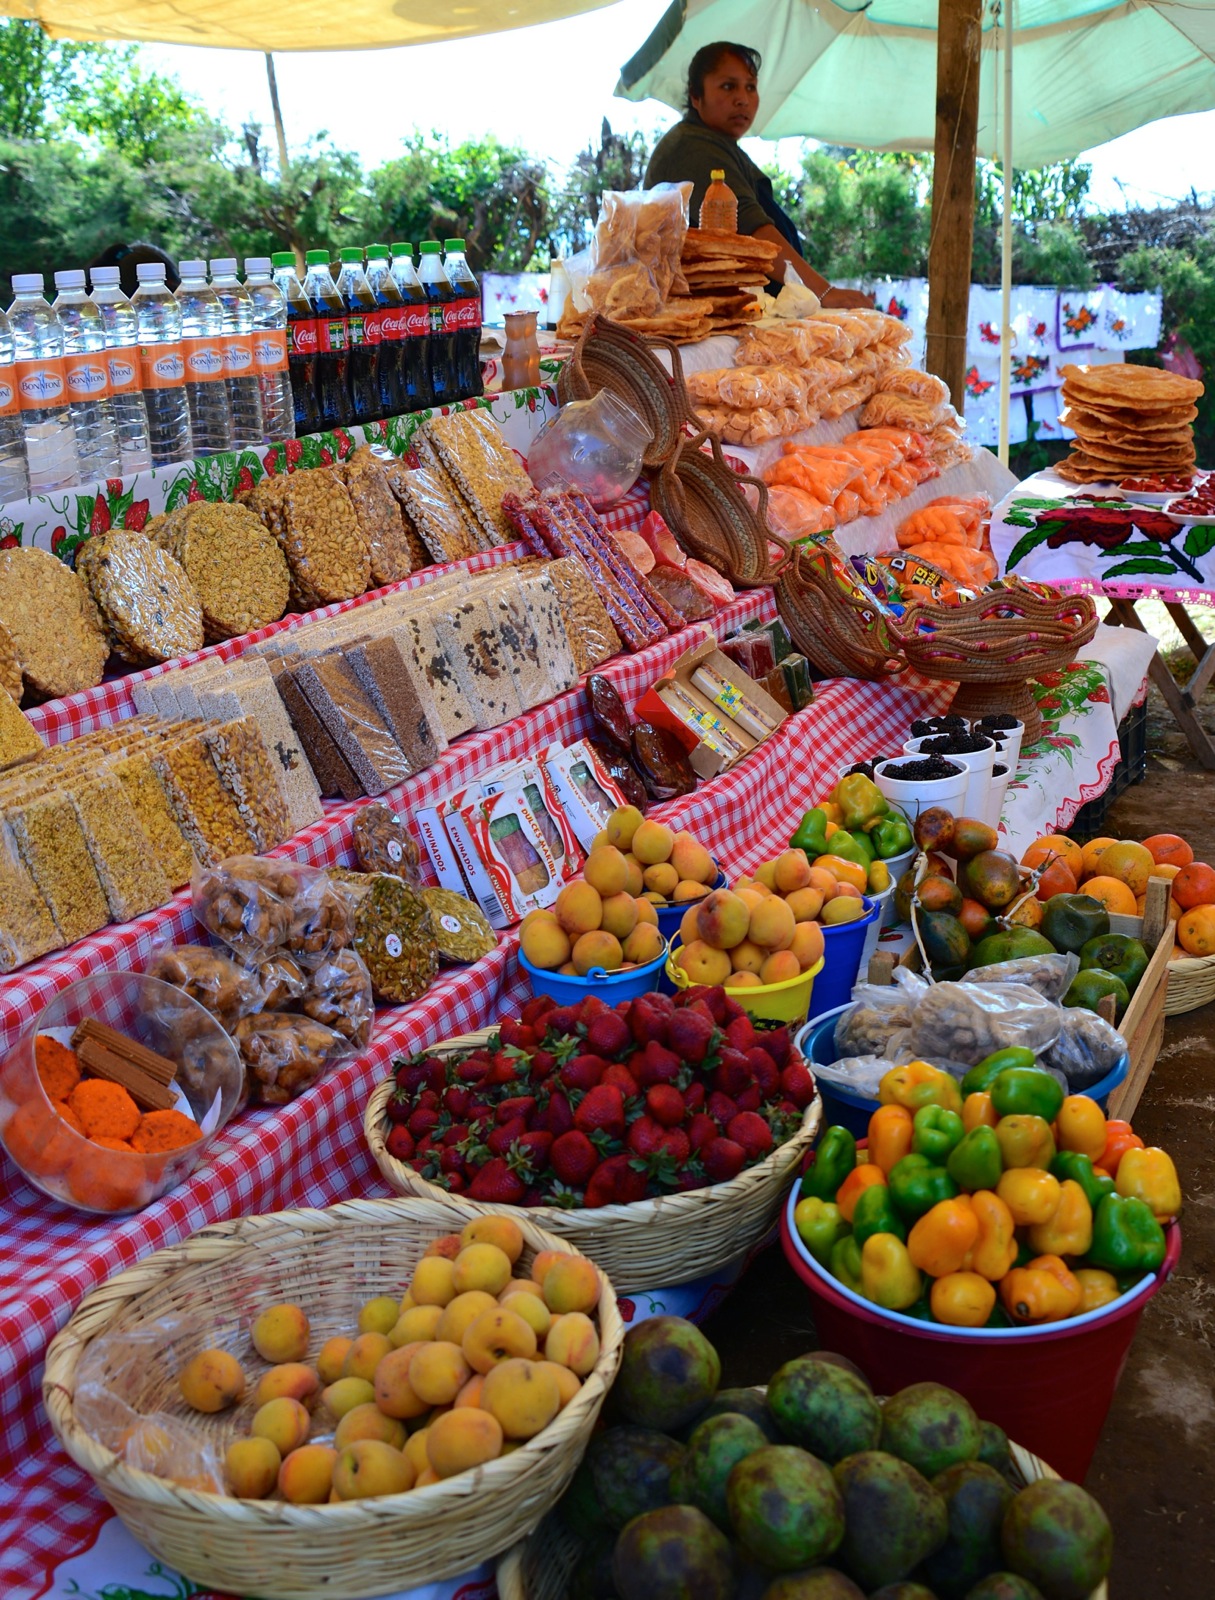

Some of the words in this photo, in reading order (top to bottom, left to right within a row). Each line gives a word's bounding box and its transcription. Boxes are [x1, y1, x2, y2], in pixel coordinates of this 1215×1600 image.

[422, 822, 446, 872] ENVINADOS
[450, 826, 476, 876] ENVINADOS
[521, 808, 542, 839] DULCES
[539, 840, 557, 879] MARIBEL
[490, 874, 515, 920] ENVINADOS
